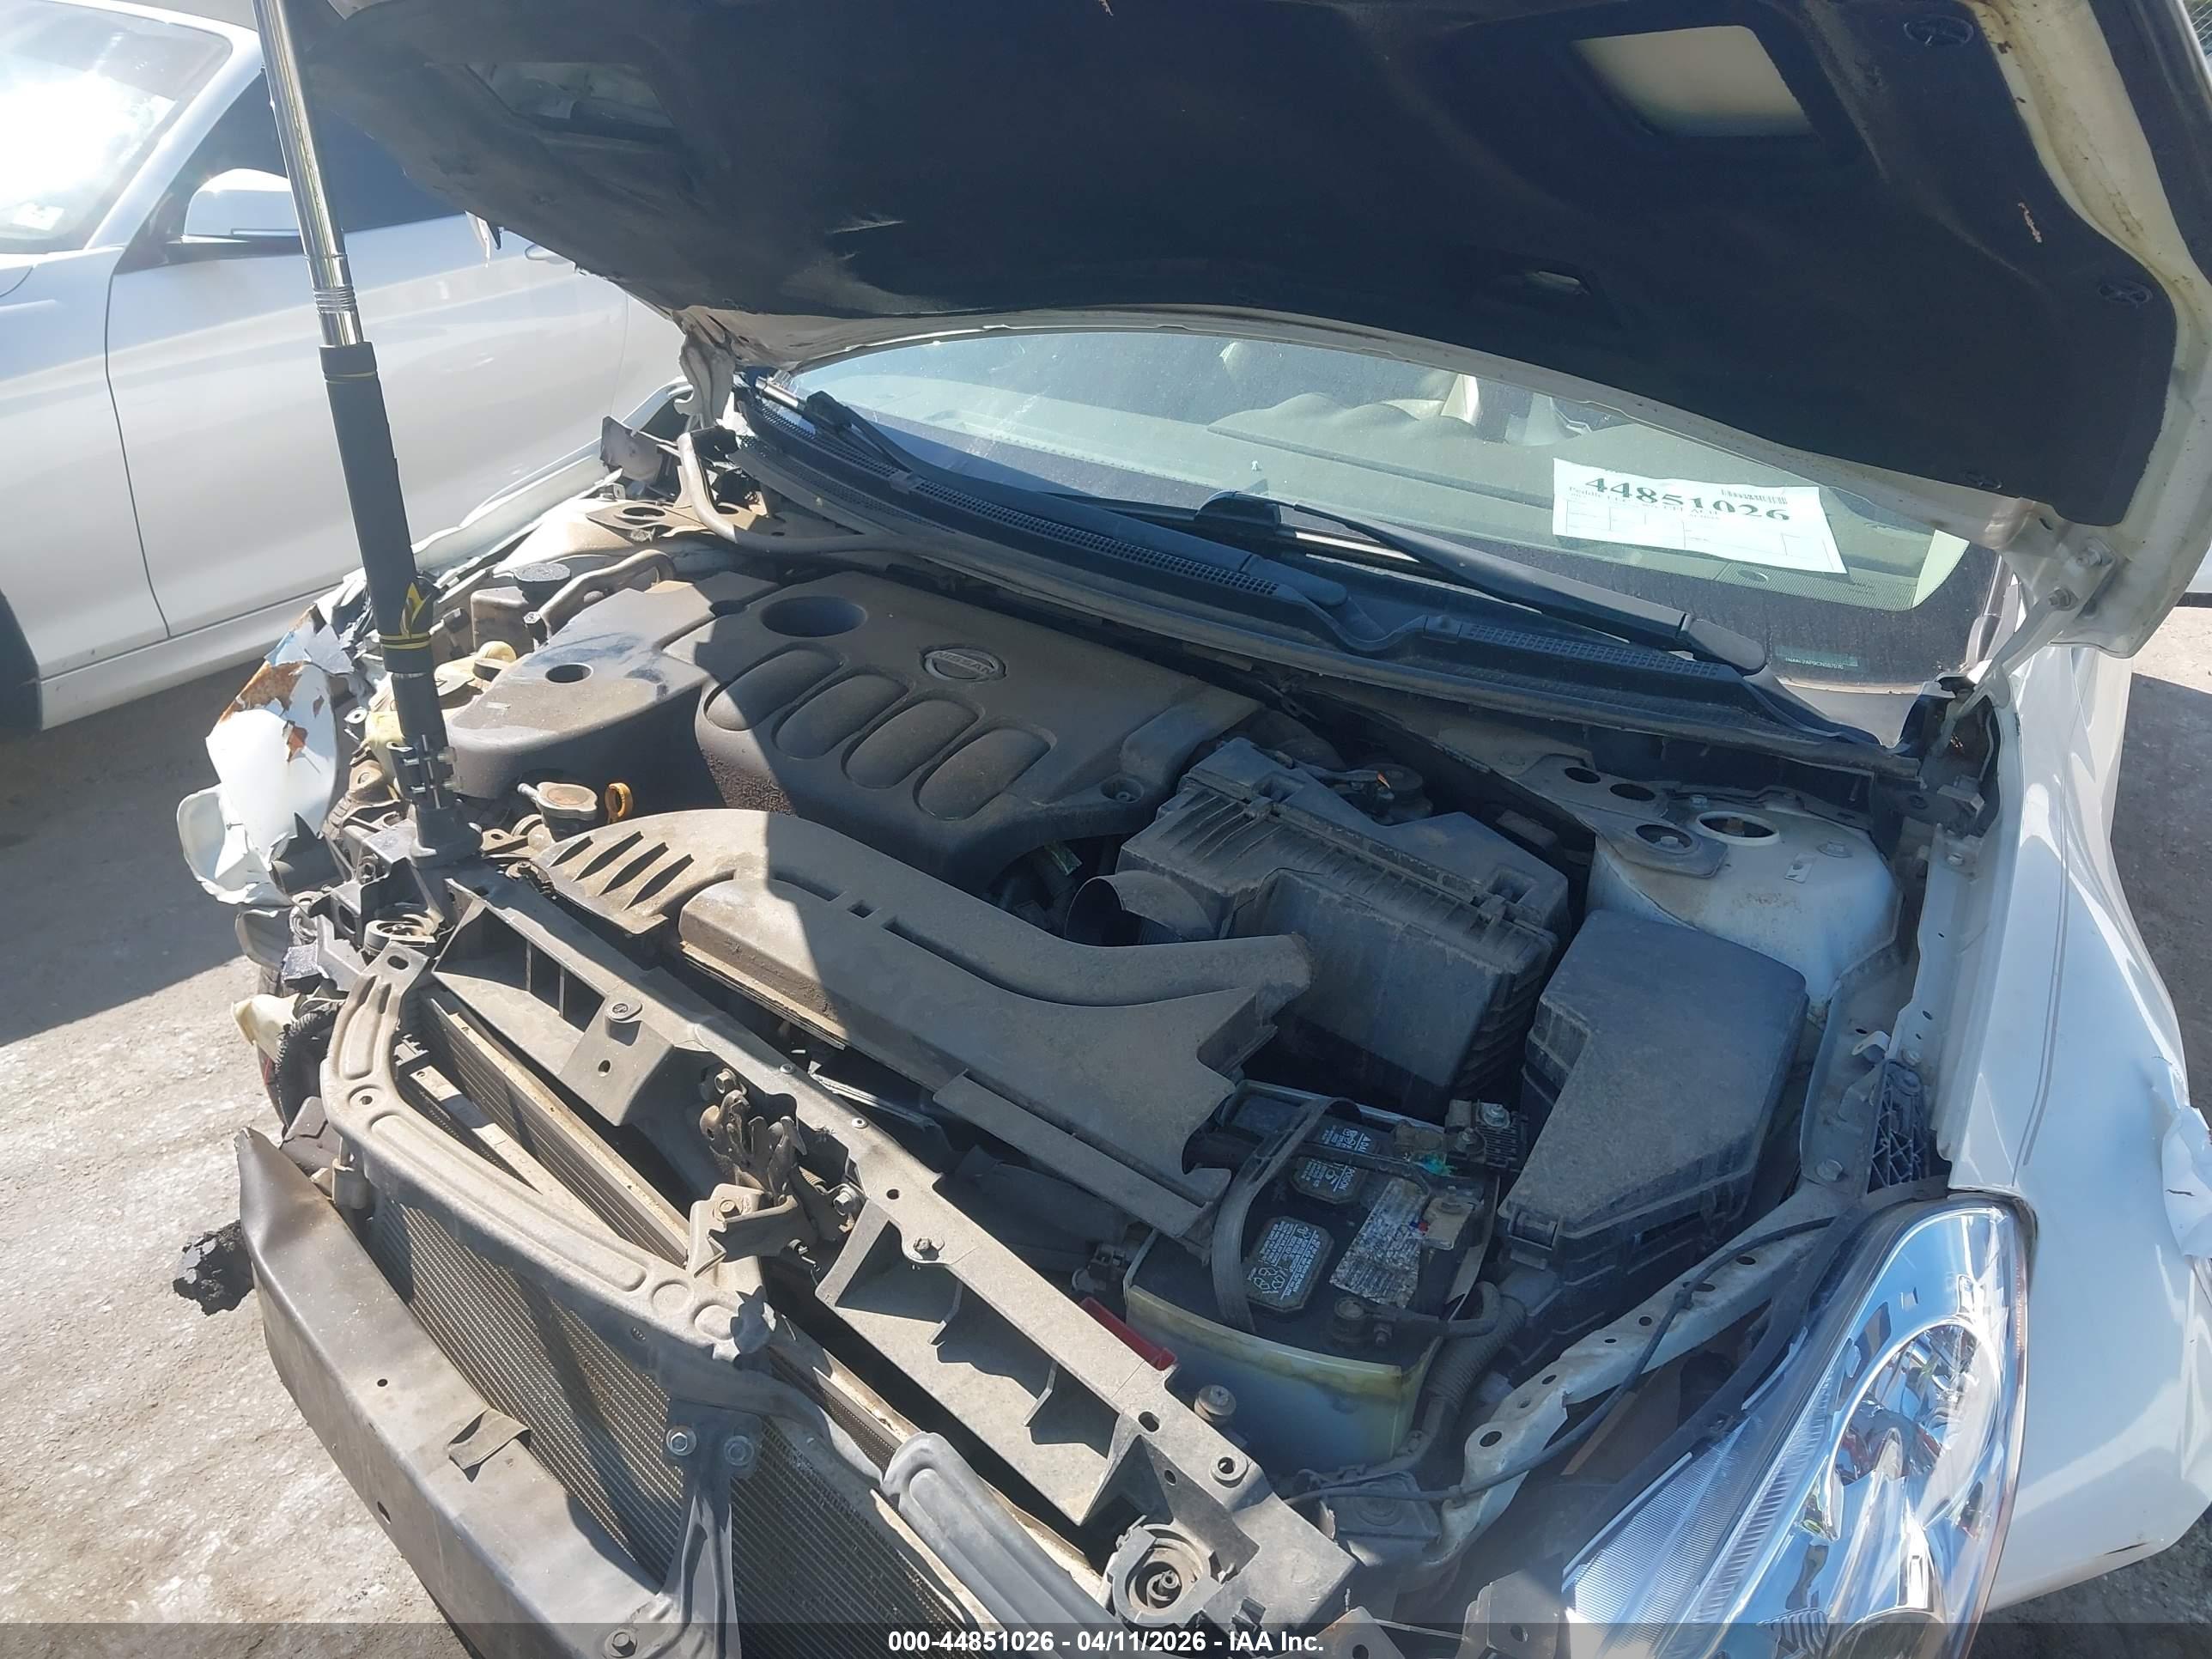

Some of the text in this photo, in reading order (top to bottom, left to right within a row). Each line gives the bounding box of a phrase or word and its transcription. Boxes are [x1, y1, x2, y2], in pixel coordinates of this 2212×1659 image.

[1584, 477, 1790, 521] 44851026
[933, 651, 991, 673] NISSAN
[1339, 1167, 1357, 1190] POISON
